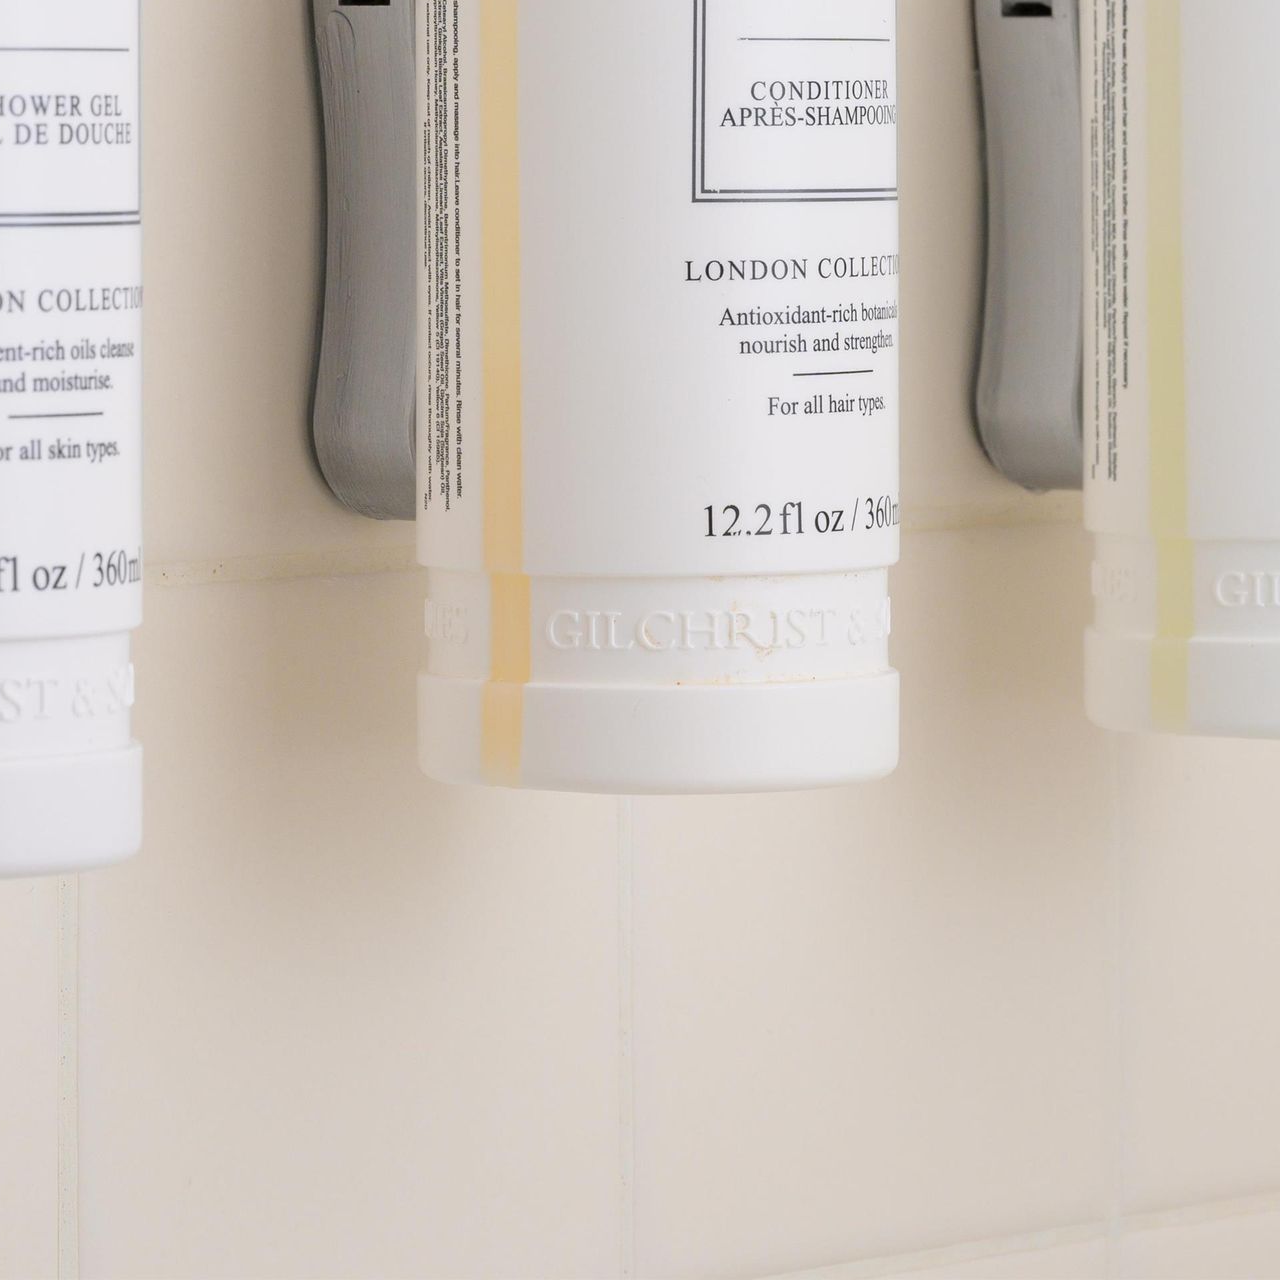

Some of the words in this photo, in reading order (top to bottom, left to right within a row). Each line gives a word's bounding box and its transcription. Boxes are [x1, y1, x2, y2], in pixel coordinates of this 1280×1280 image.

[750, 80, 889, 101] CONDITIONER
[90, 95, 122, 117] GEL
[14, 123, 49, 145] DE
[59, 122, 132, 145] DOUCHE
[685, 258, 808, 281] LONDON
[818, 254, 900, 279] COLLECTIO
[719, 303, 858, 326] Antioxidant-rich
[70, 338, 96, 361] oils
[740, 333, 808, 354] nourish
[813, 332, 840, 352] and
[33, 370, 113, 392] moisturise.
[768, 397, 799, 416] For
[804, 395, 823, 414] all
[828, 394, 855, 414] hair
[858, 394, 886, 416] types.
[19, 439, 42, 461] all
[47, 439, 81, 460] skin
[86, 439, 120, 464] types.
[704, 503, 773, 537] 12.2
[814, 509, 845, 533] oz
[32, 566, 67, 591] oz
[75, 552, 85, 589] /
[545, 607, 838, 650] GILCHRIST
